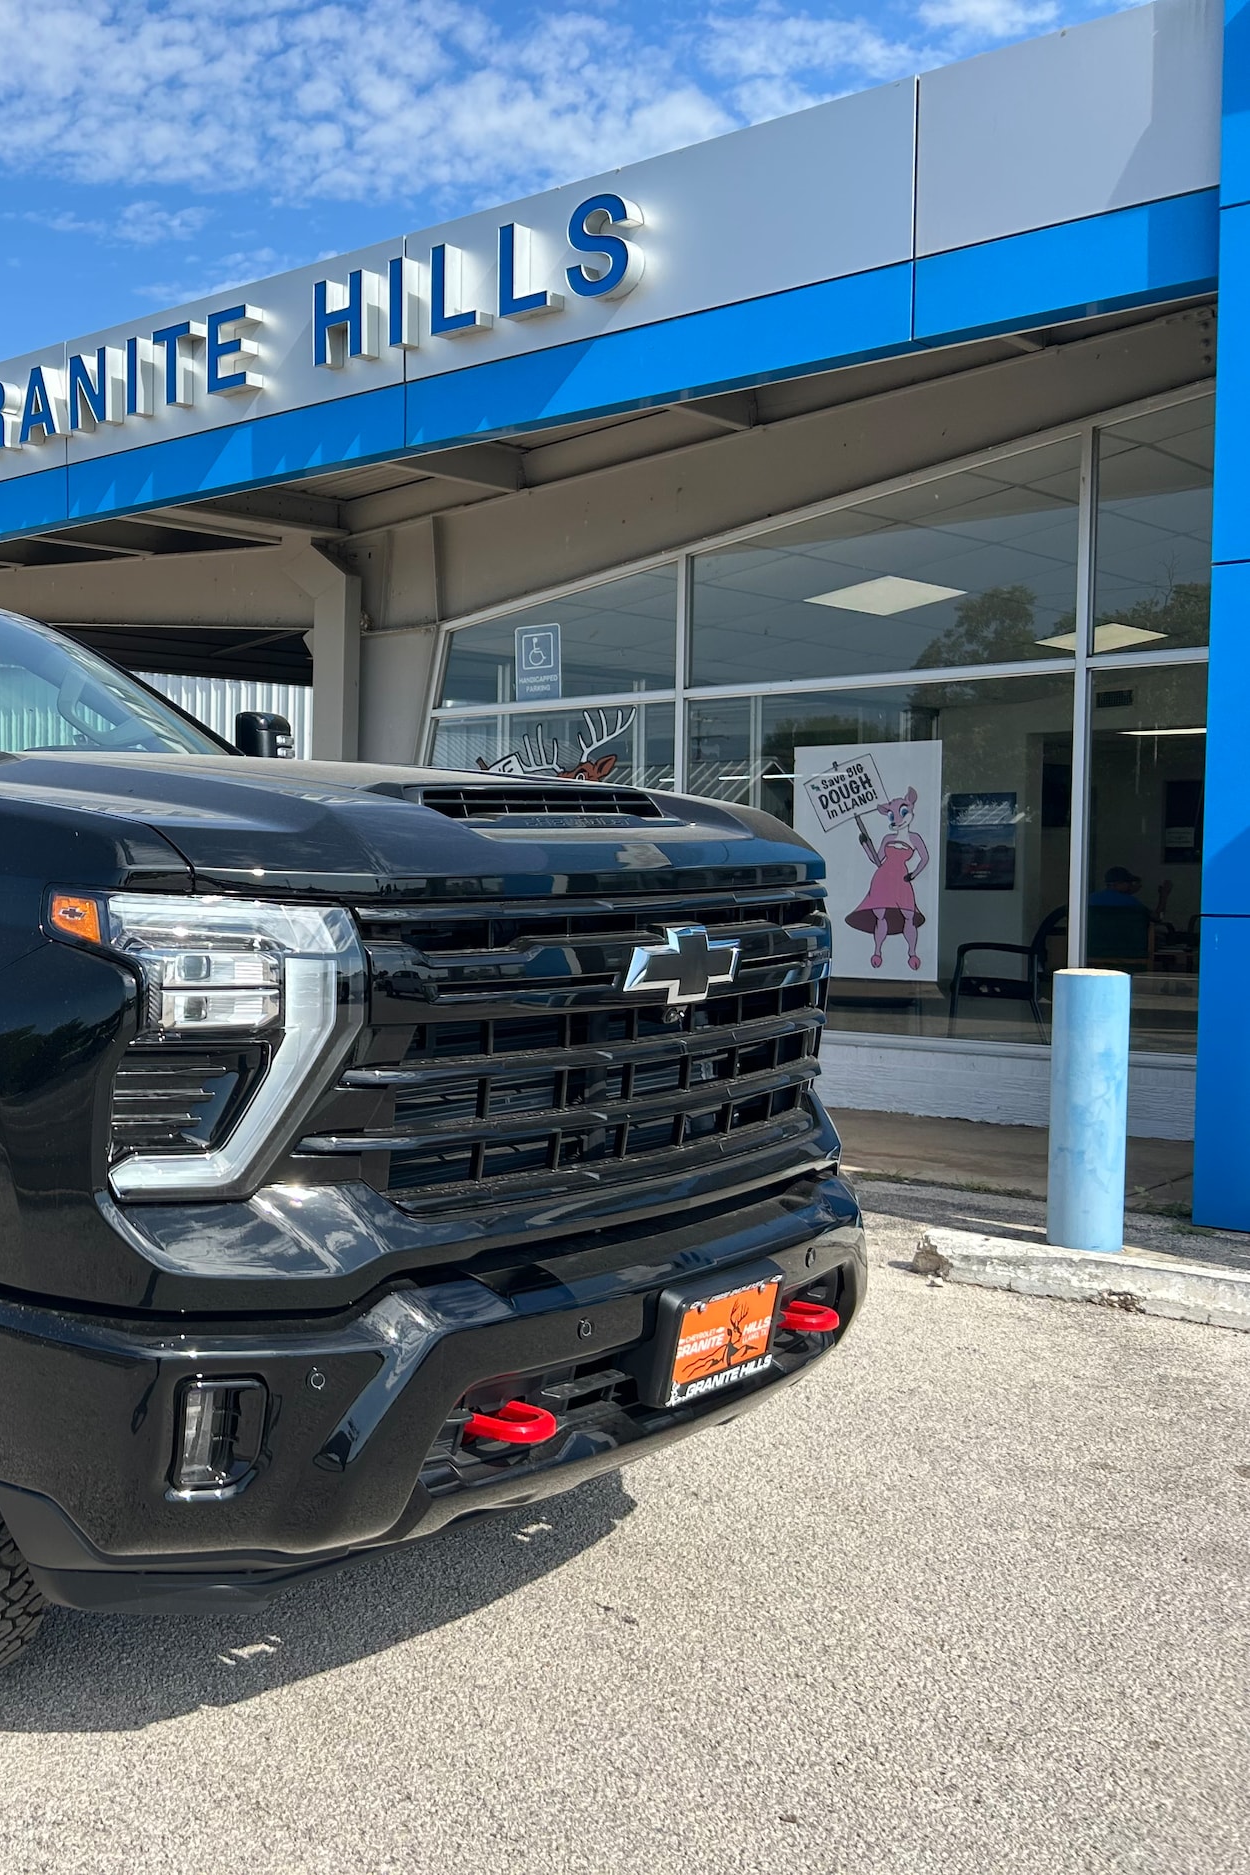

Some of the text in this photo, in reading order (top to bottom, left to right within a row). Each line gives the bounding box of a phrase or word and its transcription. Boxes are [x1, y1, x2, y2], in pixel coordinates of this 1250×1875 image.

[312, 192, 645, 368] HILLS
[518, 674, 559, 685] HANDICAPPED
[525, 684, 551, 693] PARKING
[821, 763, 864, 790] Save BIG
[818, 773, 873, 810] DOUGH
[838, 788, 878, 814] LLANO!
[742, 1316, 771, 1336] HILLS
[686, 1354, 772, 1398] GRANITE HILLS
